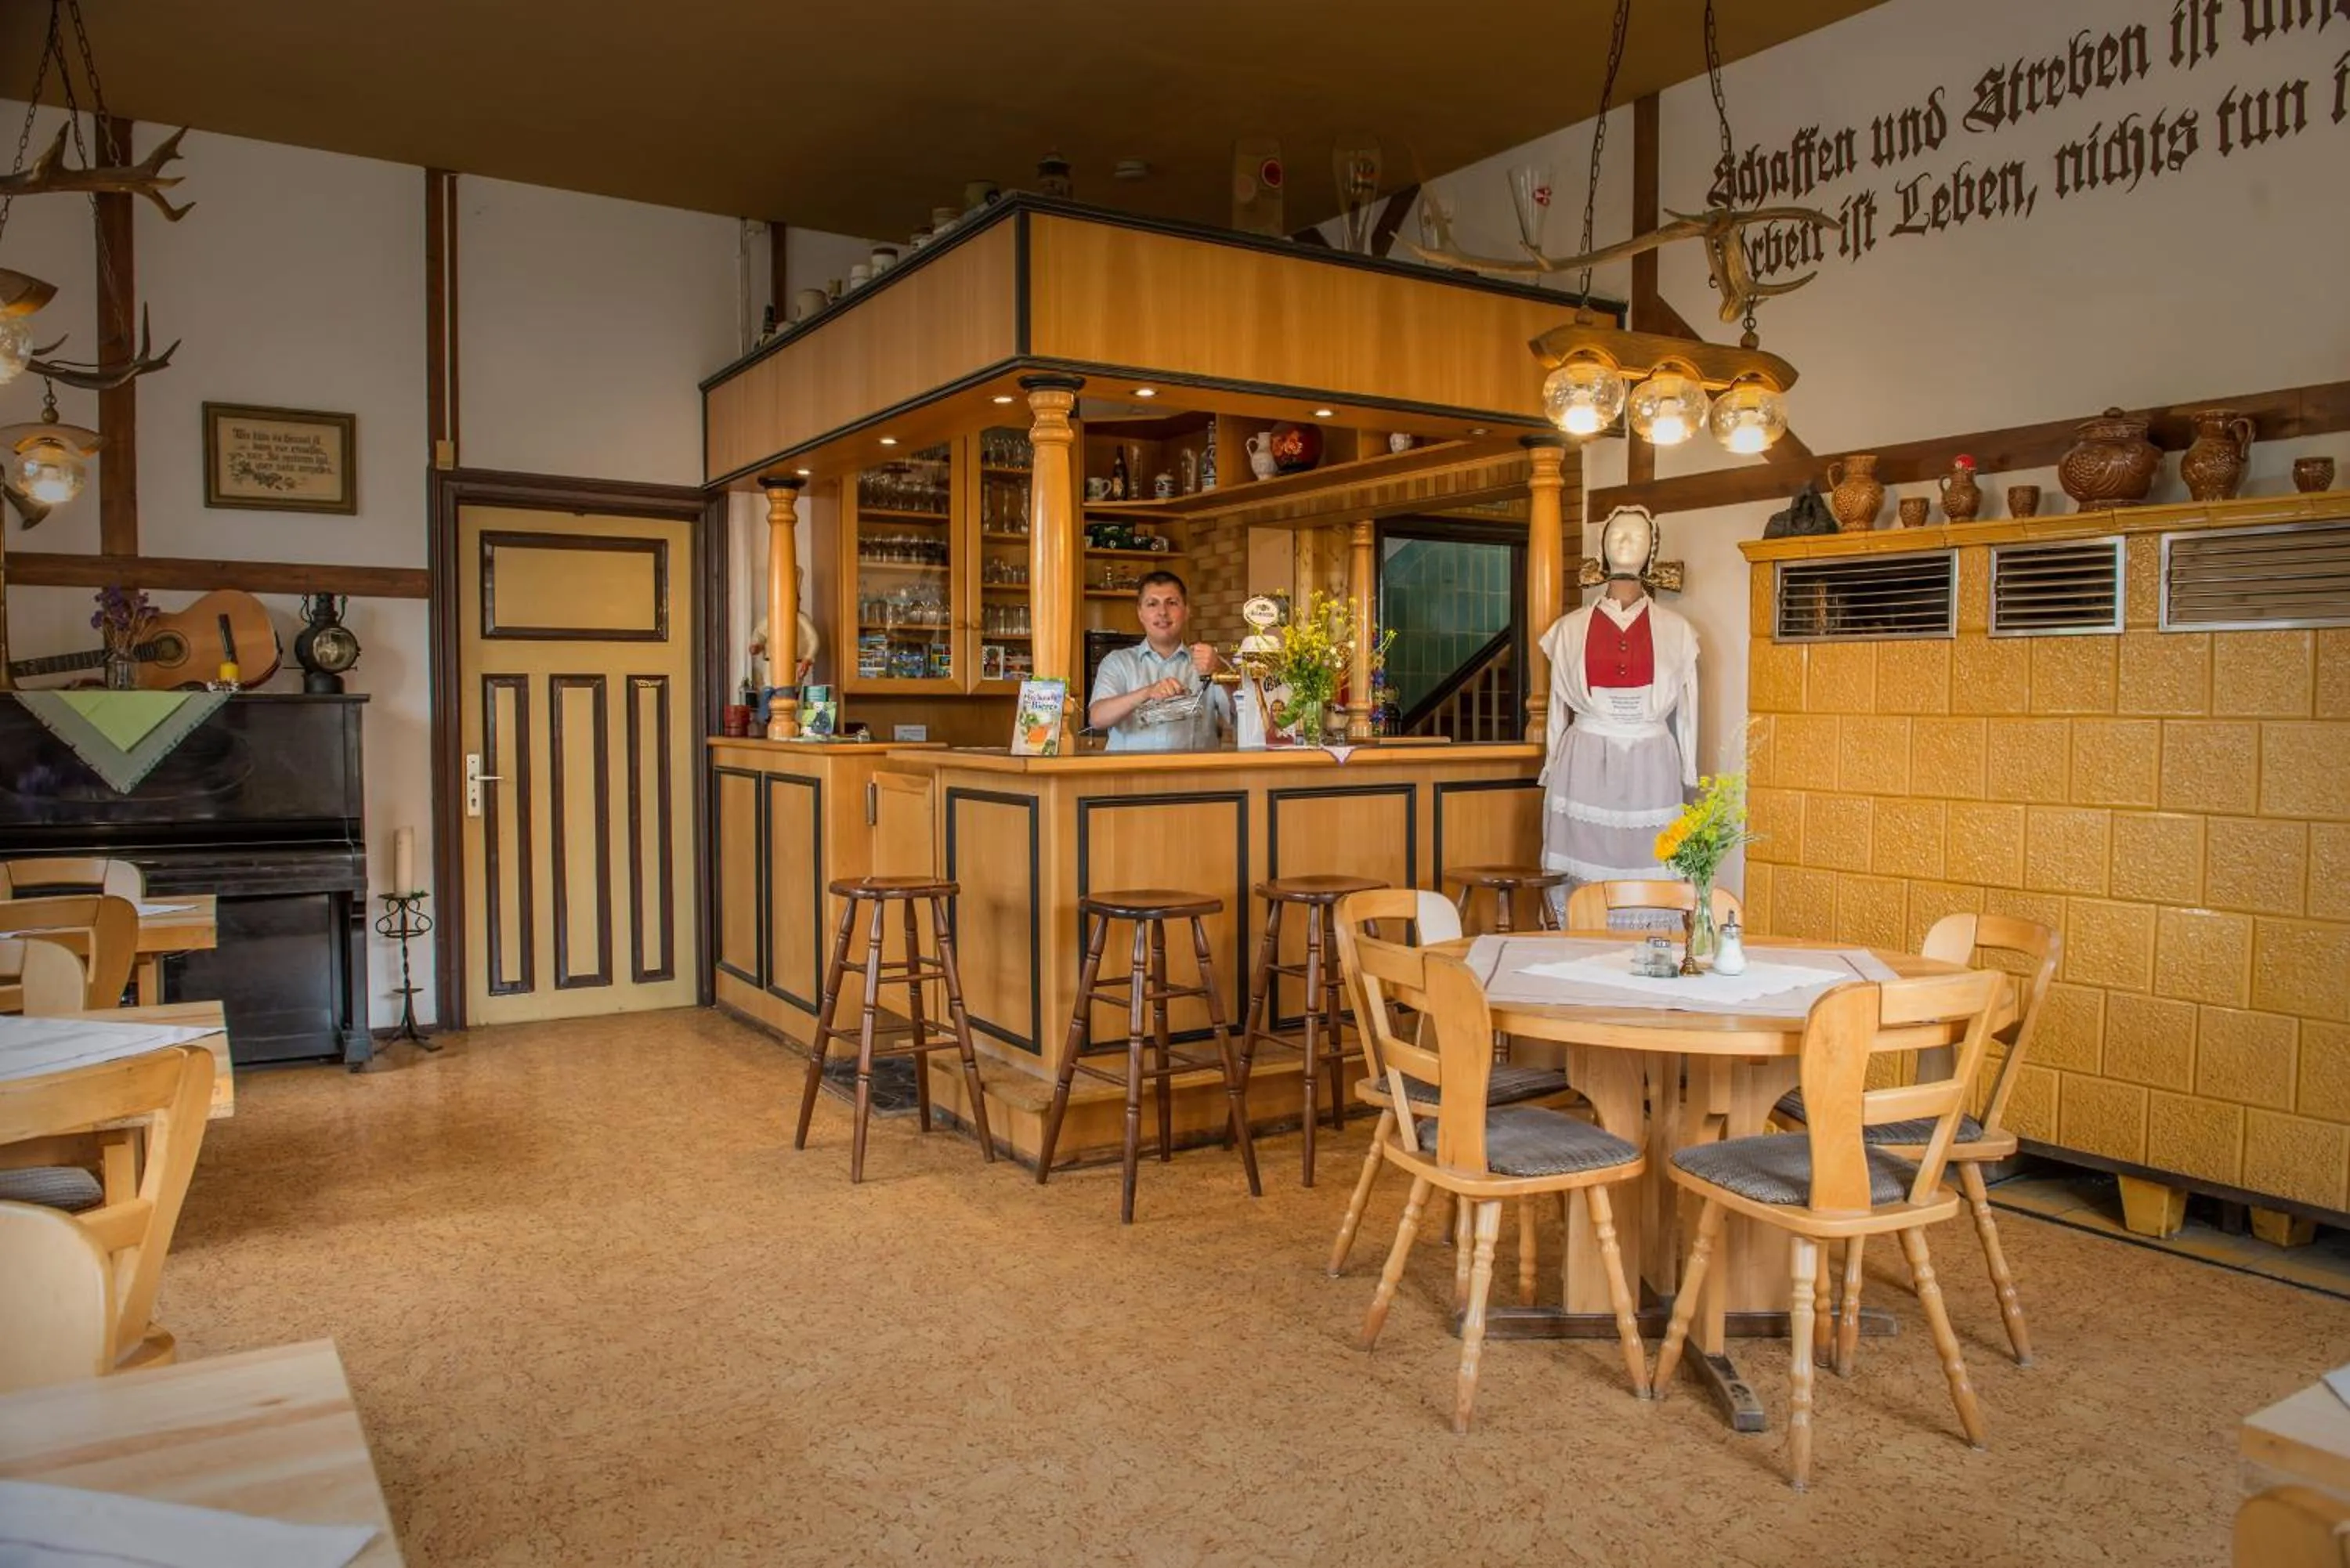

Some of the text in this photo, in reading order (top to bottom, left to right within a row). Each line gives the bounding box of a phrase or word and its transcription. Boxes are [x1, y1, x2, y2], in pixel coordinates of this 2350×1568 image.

[1706, 124, 1857, 211] Schaffen
[1871, 85, 1947, 169] und
[1962, 23, 2151, 132] Streben
[1708, 211, 1824, 288] rbeit
[1889, 161, 2037, 237] Leben,
[2054, 107, 2199, 200] nichts
[2216, 78, 2309, 157] tun
